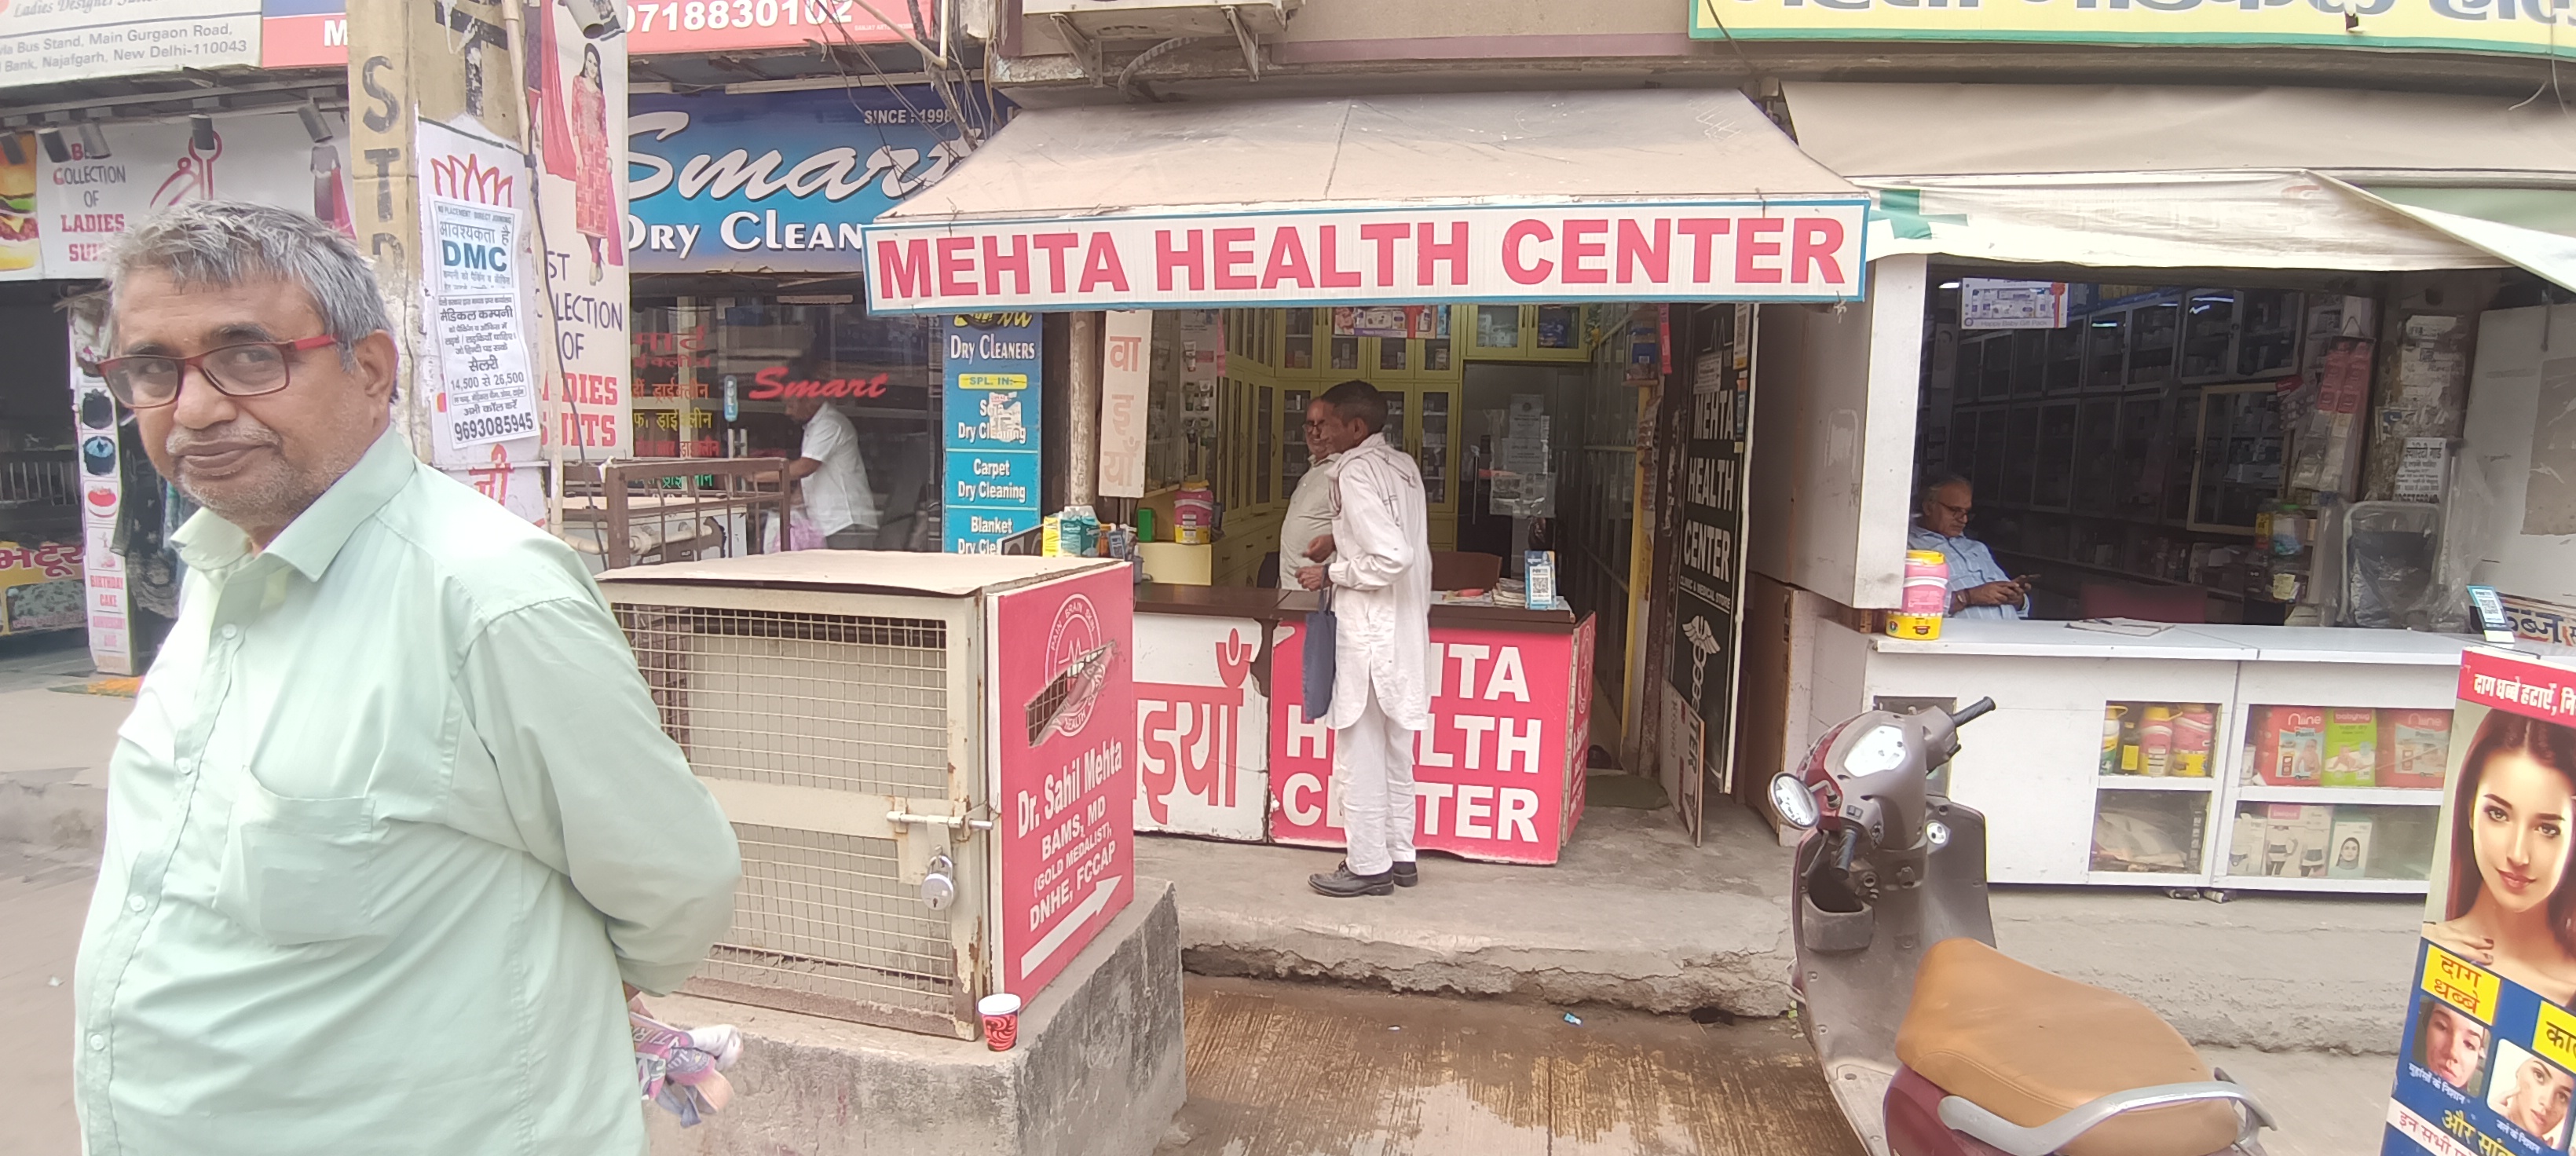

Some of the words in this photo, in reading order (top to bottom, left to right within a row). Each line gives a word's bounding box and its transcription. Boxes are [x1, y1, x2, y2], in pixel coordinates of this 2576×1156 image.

[17, 38, 39, 53] Bus
[89, 31, 123, 45] Main
[127, 27, 188, 43] Gurgaon
[193, 24, 233, 37] Road,
[5, 58, 38, 72] Bank,
[42, 51, 108, 69] Najafgarh,
[114, 47, 145, 60] New
[150, 40, 248, 58] Delhi-110043
[864, 109, 906, 124] SINCE
[53, 165, 126, 185] COLLECTION
[84, 190, 99, 208] OF
[60, 214, 125, 232] LADIES
[440, 221, 496, 243] आवश्यकता
[442, 240, 507, 272] DMC
[877, 232, 1130, 299] MEHTA
[1154, 221, 1469, 291] HEALTH
[1502, 218, 1846, 285] CENTER
[562, 331, 584, 360] OF
[451, 377, 479, 391] 14,500
[494, 371, 524, 386] 26,500
[748, 366, 888, 399] Smart
[455, 412, 533, 441] 9693085945
[1692, 389, 1734, 441] MEHTA
[958, 423, 976, 444] Dry
[973, 459, 1010, 479] Carpet
[958, 481, 976, 501] Dry
[979, 481, 1026, 502] Cleaning
[1687, 457, 1735, 511] HEALTH
[971, 515, 1013, 535] Blanket
[1683, 519, 1731, 583] CENTER
[90, 575, 123, 590] BIRTHDAY
[100, 594, 117, 607] CAKE
[2474, 673, 2497, 697] दाग
[1018, 789, 1040, 839] Dr.
[1045, 757, 1081, 820] Sahil
[1084, 737, 1122, 794] Mehta
[1088, 796, 1107, 827] MD
[1030, 878, 1074, 932] DNHE,
[1077, 841, 1115, 891] FCCAP
[1034, 858, 1063, 898] (GOLD
[2440, 954, 2482, 989] दाग
[2434, 978, 2481, 1014] धब्बे
[2399, 1110, 2418, 1133] इन
[2442, 1110, 2477, 1144] और
